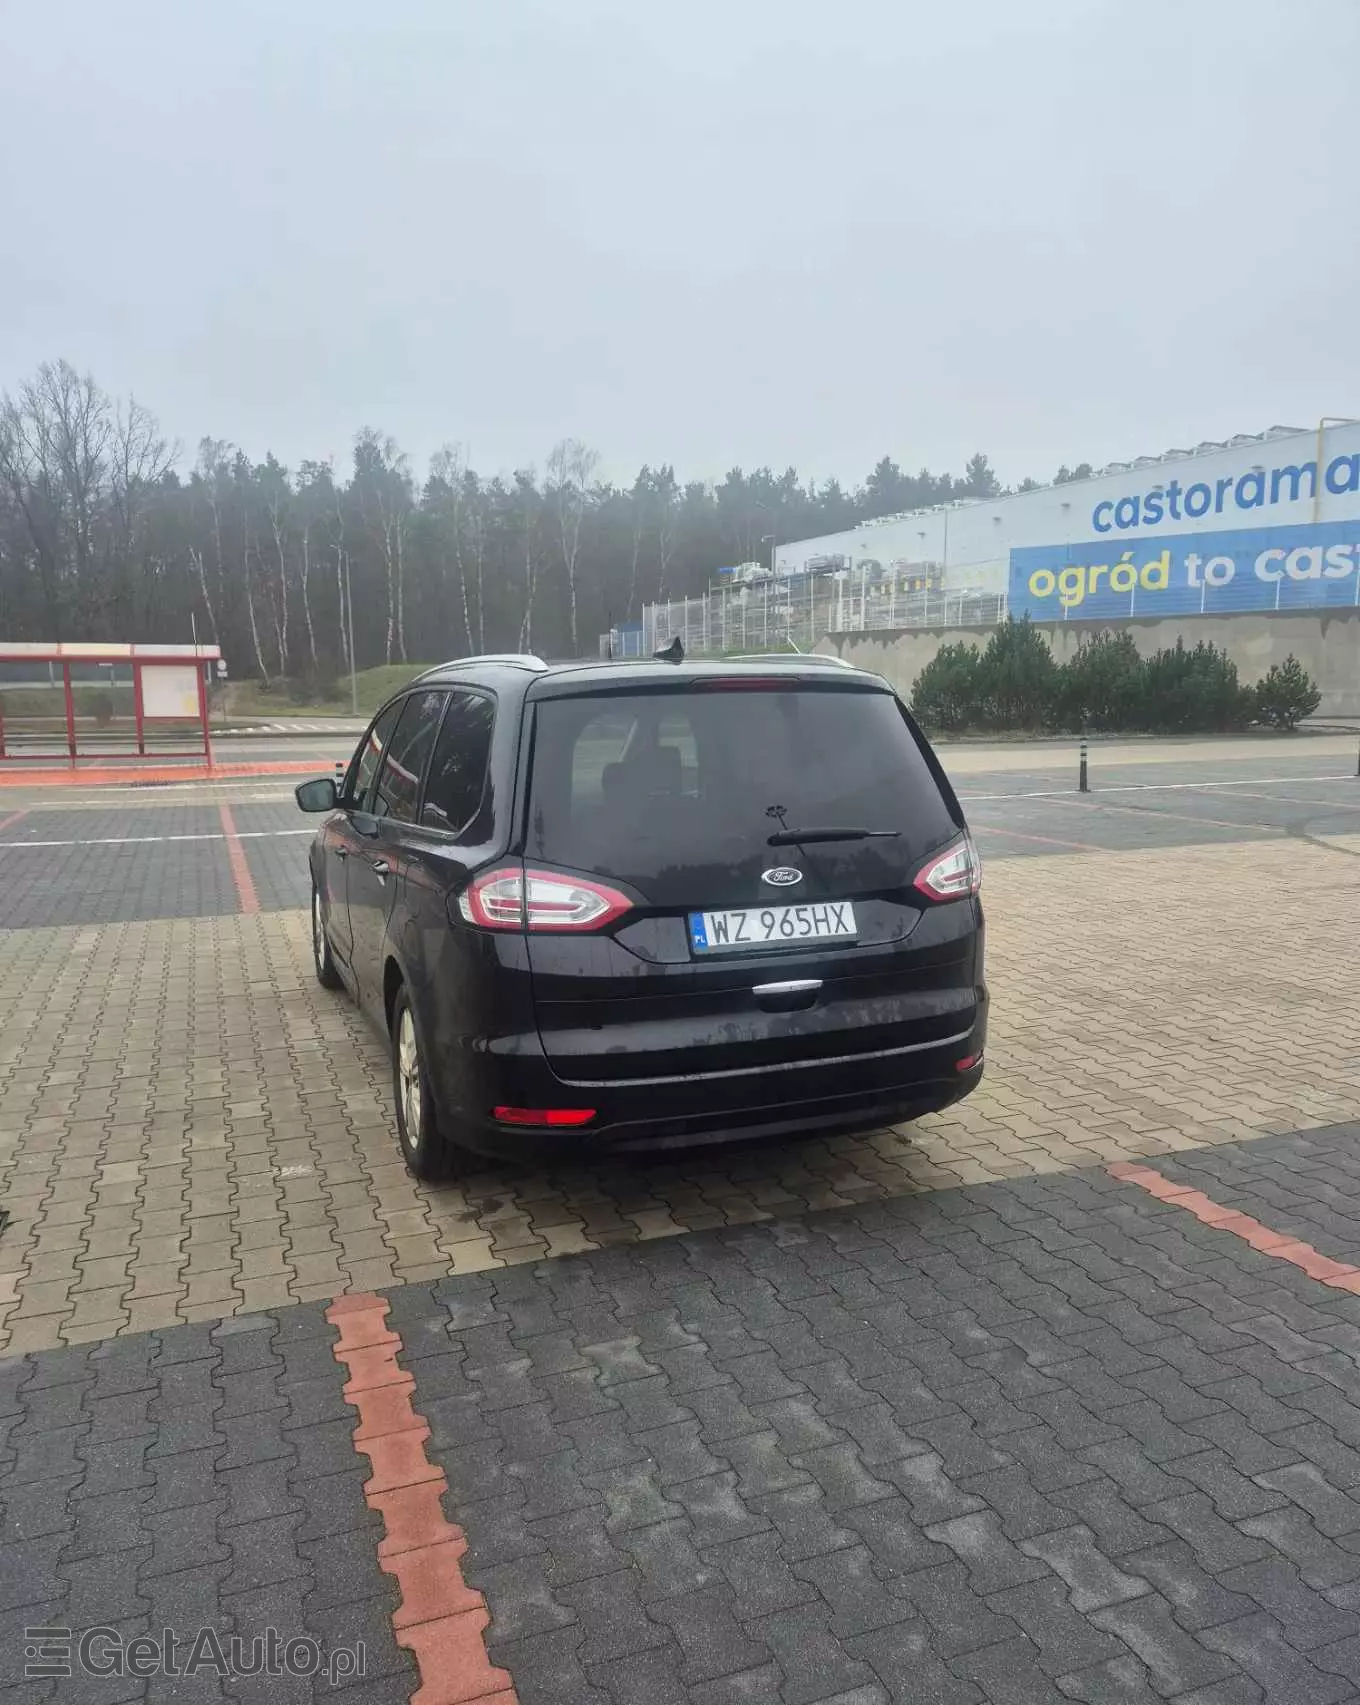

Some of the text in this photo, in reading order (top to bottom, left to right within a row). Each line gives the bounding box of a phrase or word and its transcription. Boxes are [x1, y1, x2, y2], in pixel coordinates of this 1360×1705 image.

[1092, 453, 1360, 533] castorama
[1028, 543, 1360, 606] ogród to cas
[694, 934, 706, 943] PL
[710, 904, 849, 943] WZ 965HX
